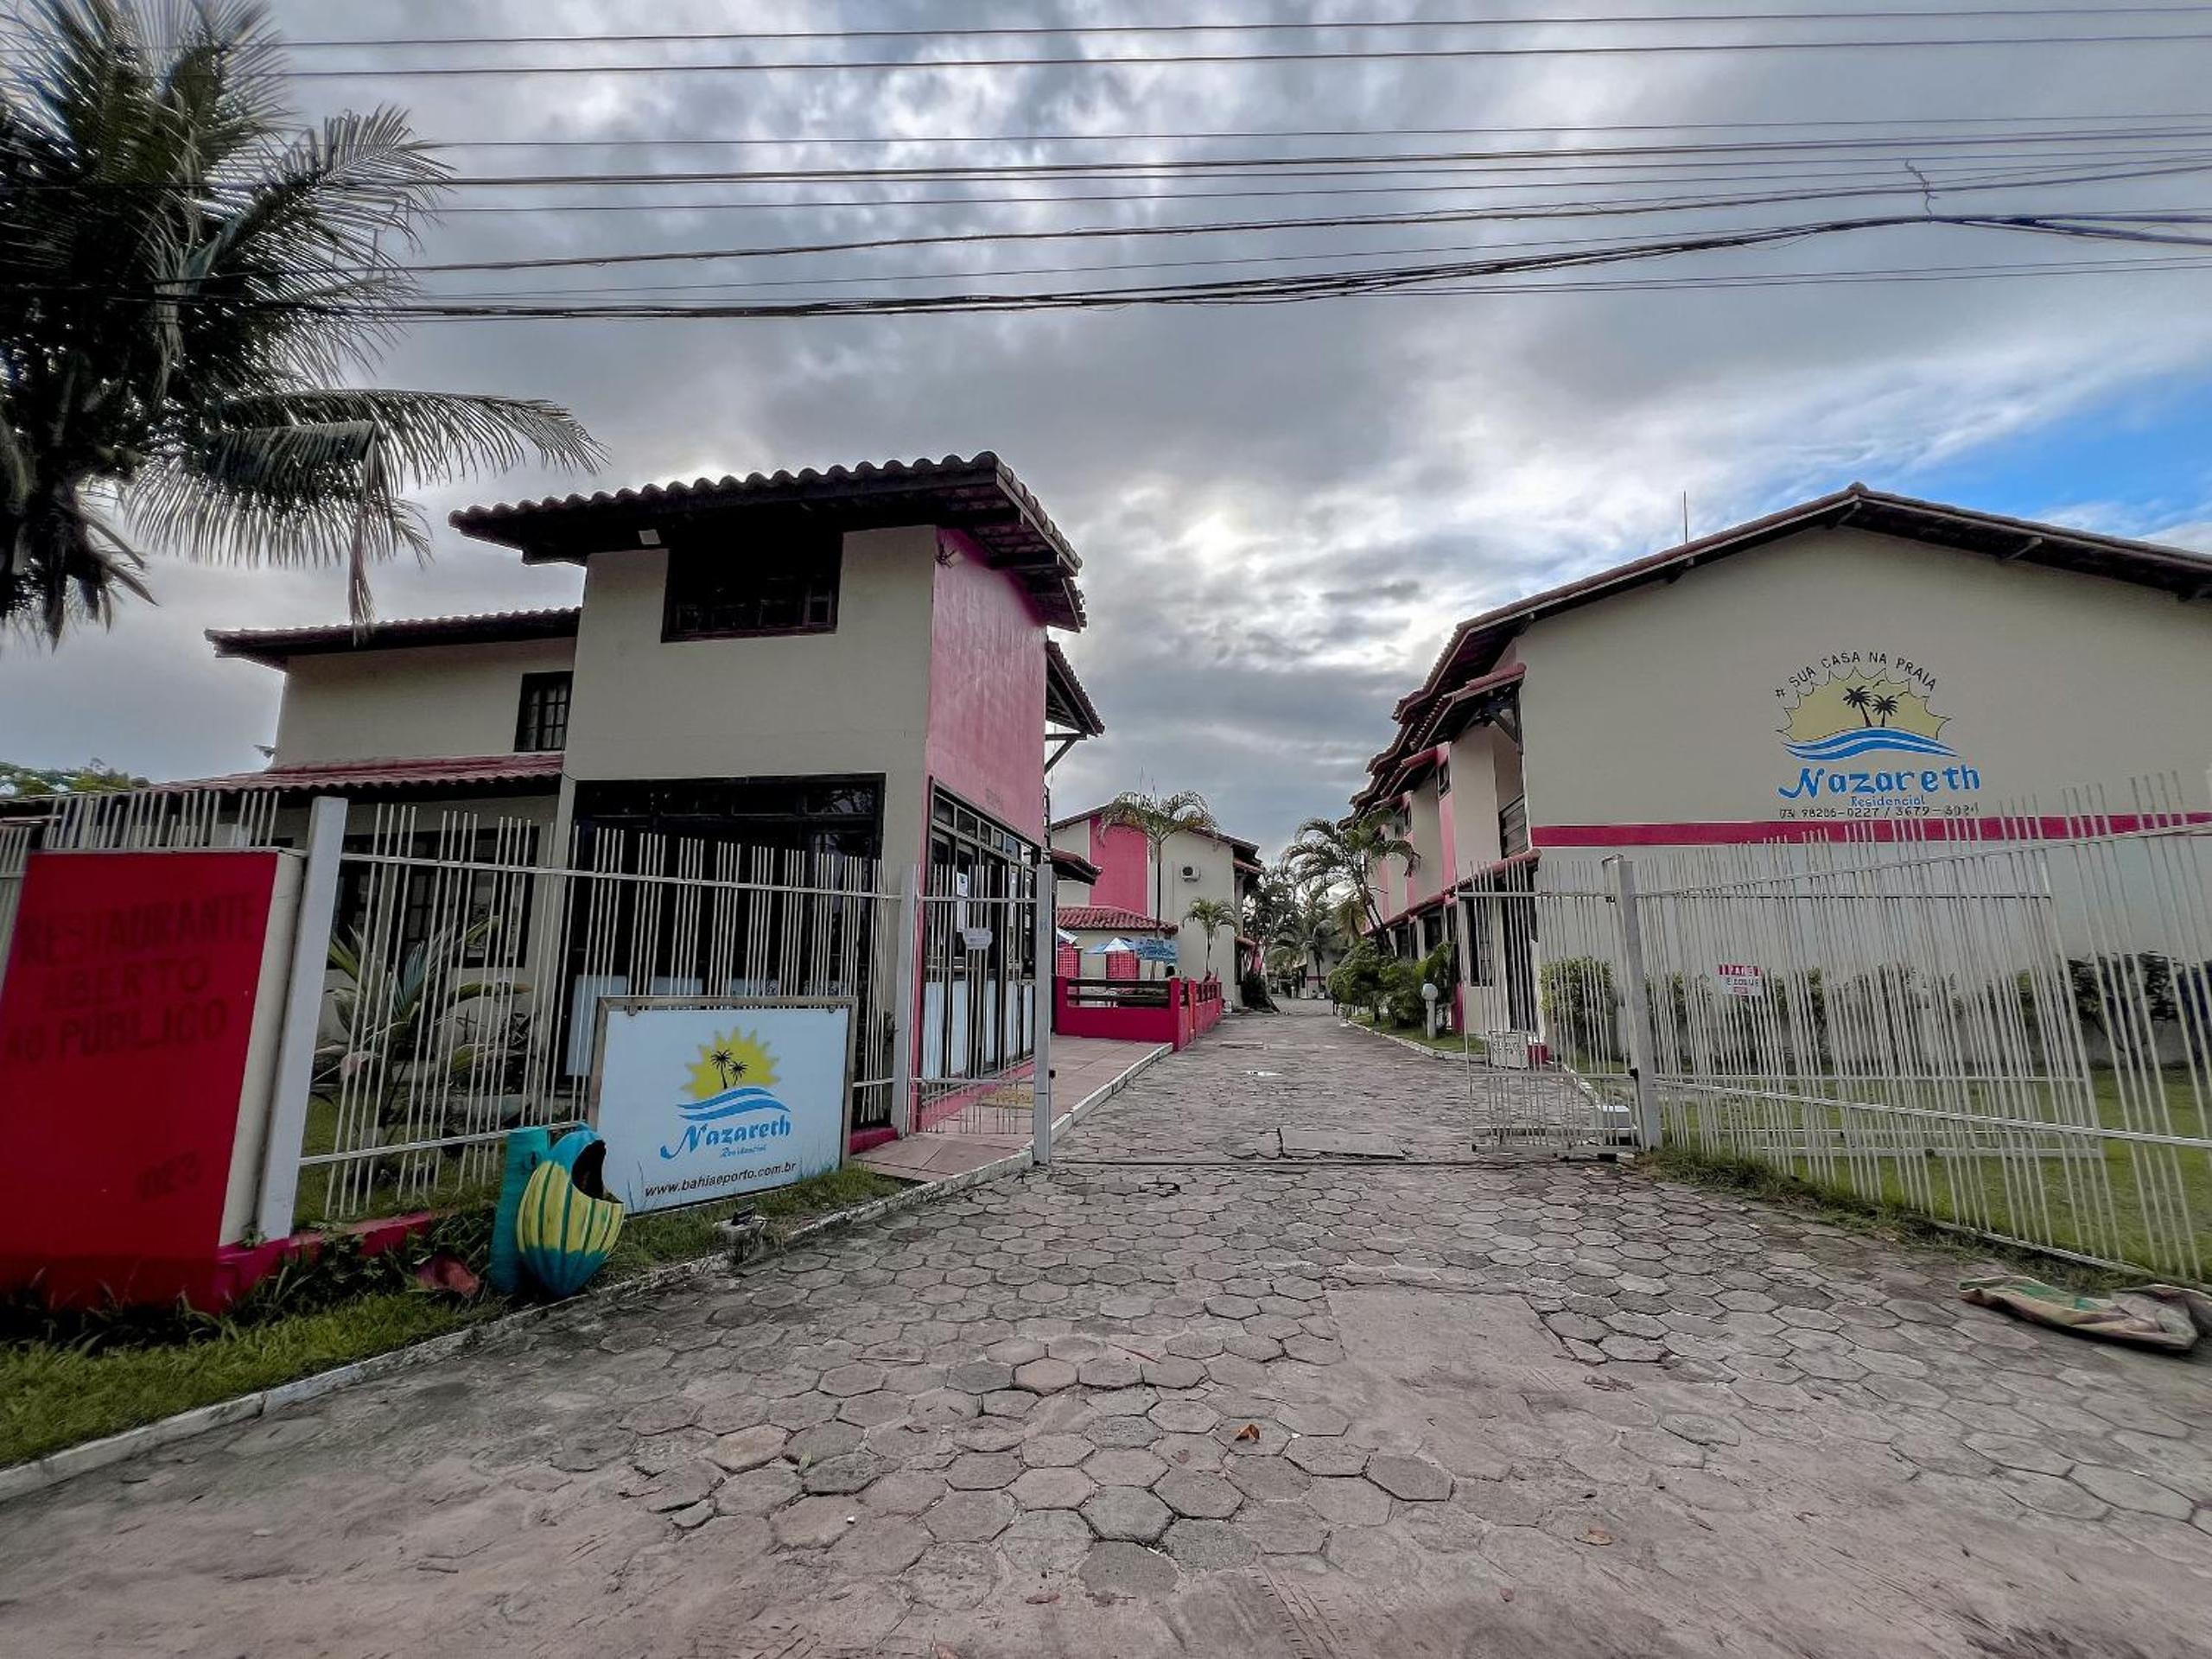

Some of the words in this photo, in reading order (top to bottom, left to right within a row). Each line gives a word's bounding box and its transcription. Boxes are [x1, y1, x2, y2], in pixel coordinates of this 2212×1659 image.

[1788, 666, 1816, 688] SUA
[1821, 652, 1860, 669] CASA
[1869, 652, 1887, 664] NA
[1896, 658, 1936, 691] PRAIA
[1777, 764, 1980, 798] Nazareth
[1852, 795, 1925, 807] Residencial
[41, 956, 209, 1011] ABERTO
[659, 1114, 791, 1160] Nazareth
[644, 1161, 797, 1198] www.bahiaeporto.com.br
